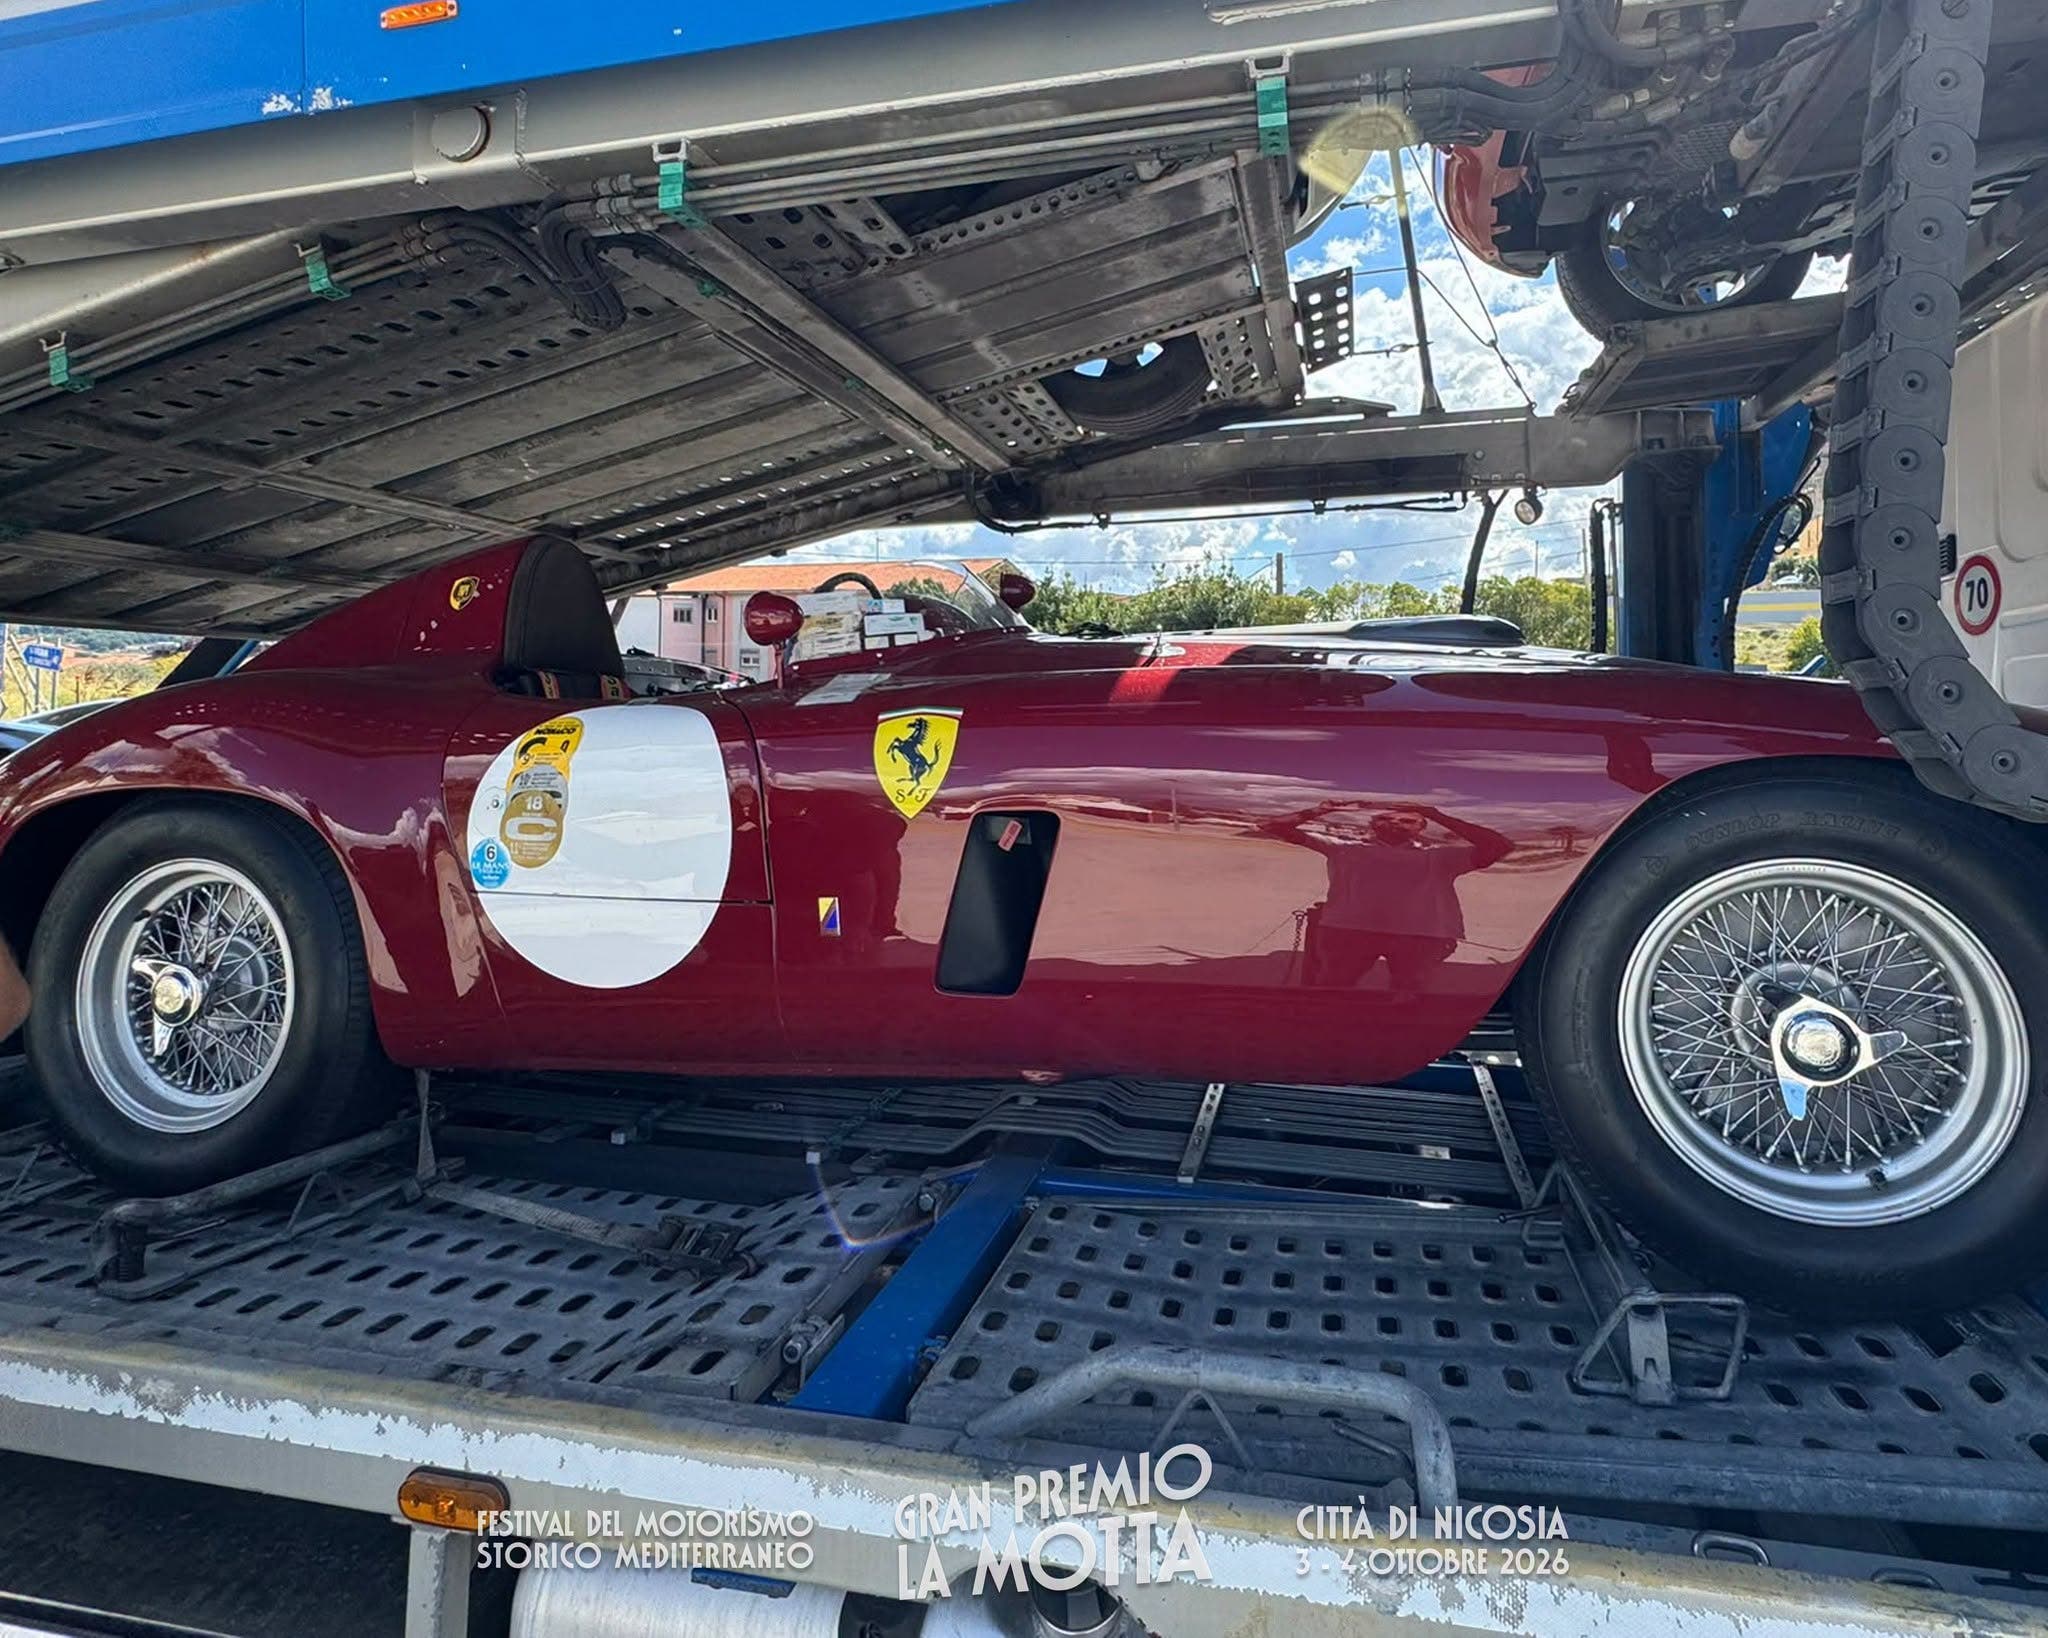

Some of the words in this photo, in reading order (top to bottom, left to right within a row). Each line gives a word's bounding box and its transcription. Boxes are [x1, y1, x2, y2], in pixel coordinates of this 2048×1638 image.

[1965, 577, 1989, 612] 70
[526, 795, 544, 811] 18
[895, 788, 906, 803] S
[486, 845, 496, 861] 6
